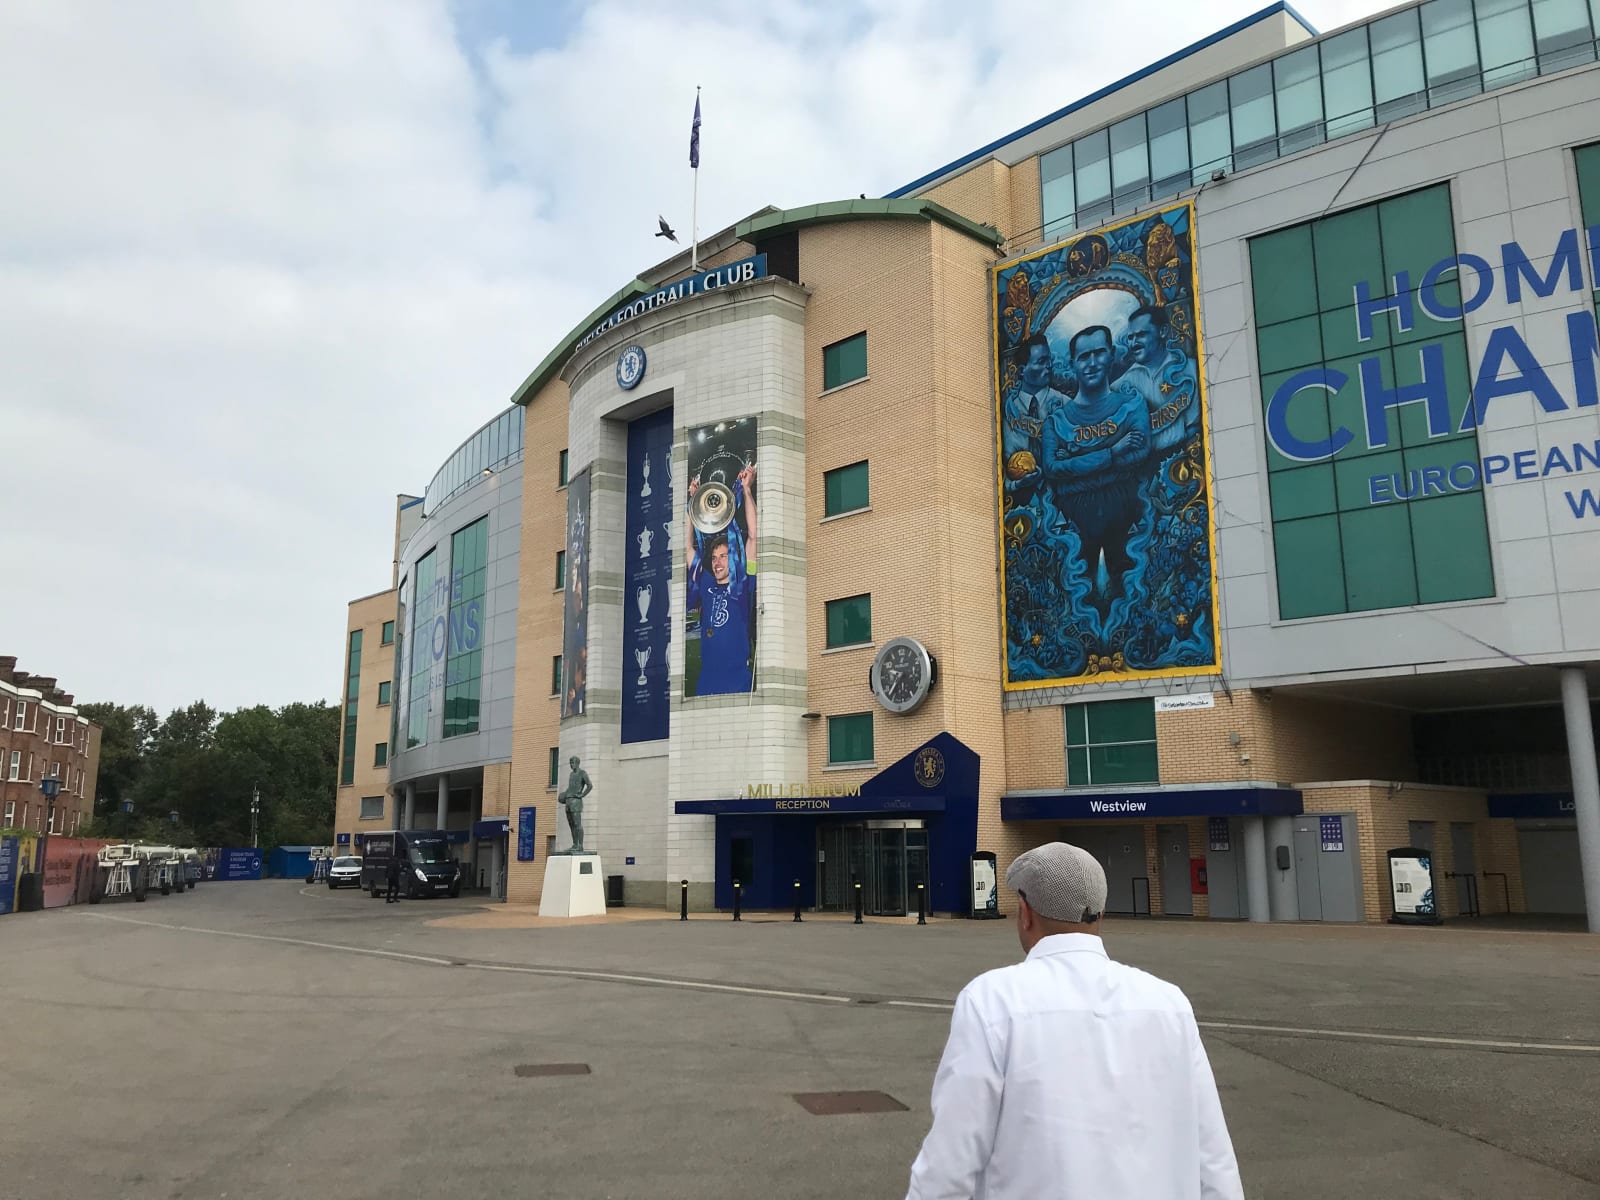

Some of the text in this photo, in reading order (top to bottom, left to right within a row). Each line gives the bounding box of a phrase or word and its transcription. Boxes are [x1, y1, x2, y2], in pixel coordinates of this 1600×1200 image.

[617, 280, 695, 323] FOOTBALL
[704, 262, 755, 291] CLUB
[1266, 310, 1600, 463] CHA
[1150, 393, 1191, 430] HIRSCH
[1073, 419, 1119, 442] JONES
[434, 569, 464, 607] THE
[747, 783, 861, 799] MILLENNIUM
[775, 800, 830, 810] RECEPTION
[1090, 800, 1147, 813] Westview
